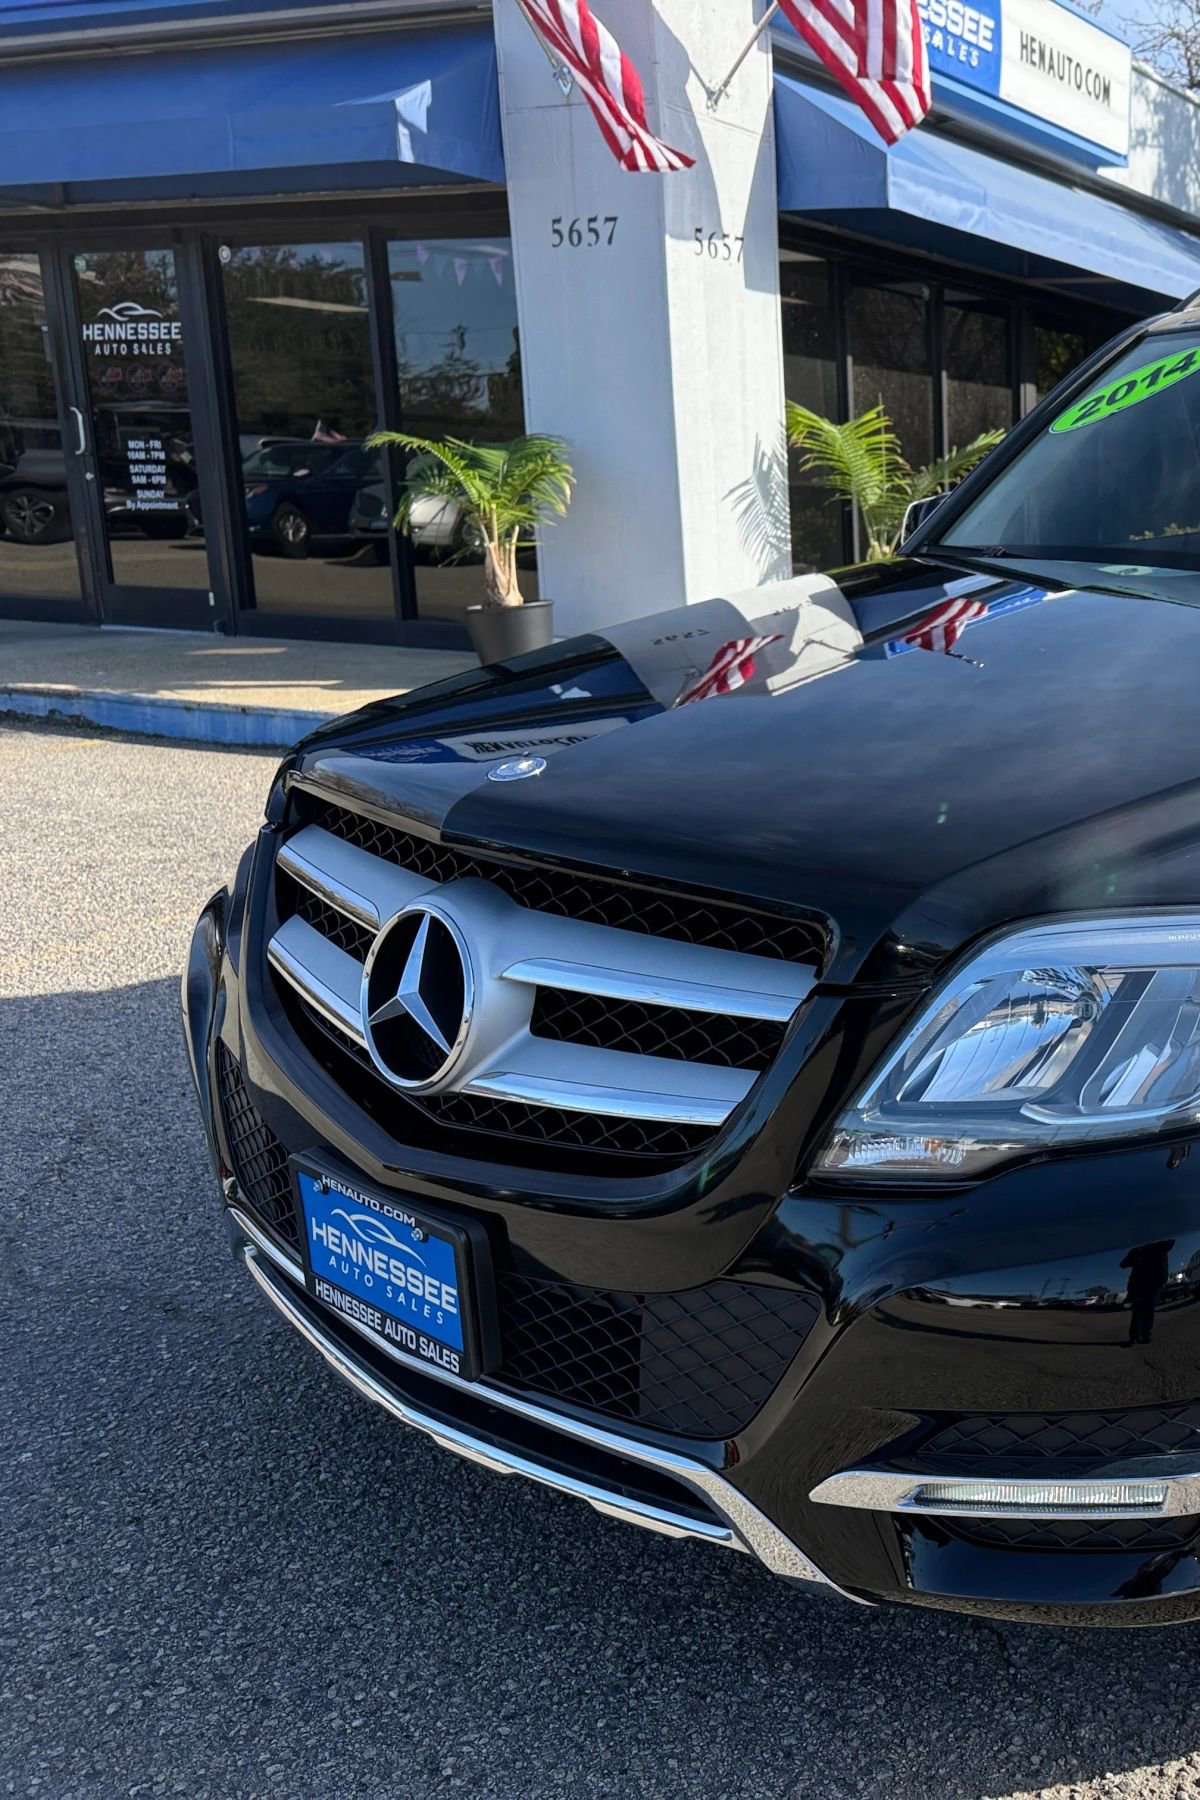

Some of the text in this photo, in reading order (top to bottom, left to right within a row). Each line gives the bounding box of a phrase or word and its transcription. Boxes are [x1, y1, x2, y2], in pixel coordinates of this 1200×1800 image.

[923, 24, 980, 68] SALES
[551, 216, 618, 248] 5657
[694, 227, 744, 263] 5657
[82, 322, 182, 341] HENNESSEE
[94, 342, 172, 356] AUTO SALES
[1070, 350, 1199, 426] 2014
[127, 439, 145, 449] MON
[149, 439, 162, 449] FRI
[129, 464, 166, 474] SATURDAY
[126, 499, 179, 511] By Appointment
[136, 489, 165, 499] SUNDAY
[321, 1174, 416, 1228] HENAUTO.COM
[311, 1216, 458, 1315] HENNESSEE
[328, 1255, 444, 1325] AUTO SALES
[315, 1278, 460, 1374] HENNESSEE AUTO SALES
